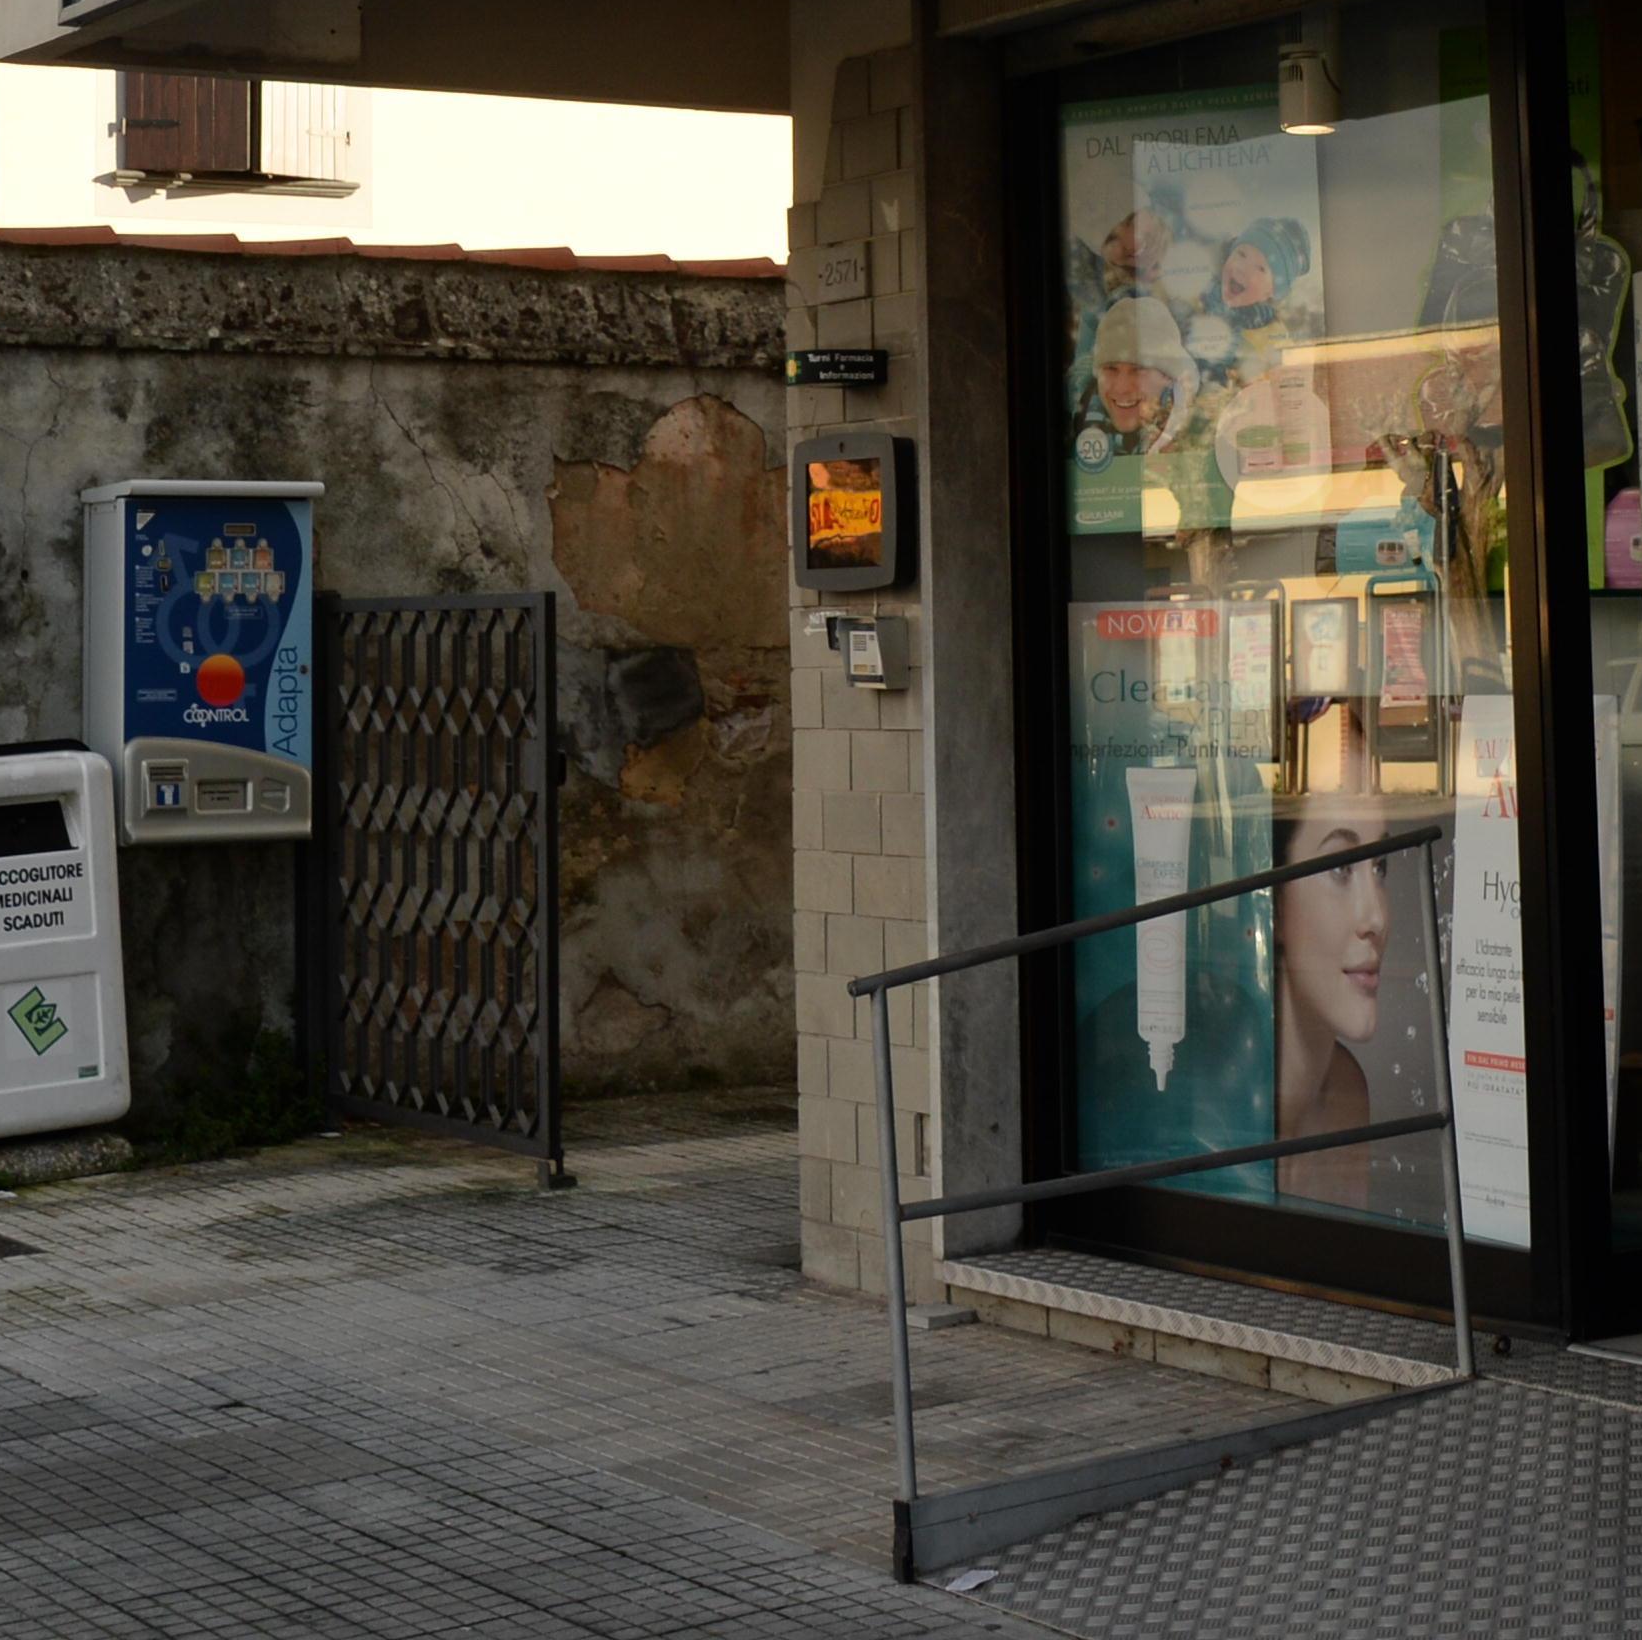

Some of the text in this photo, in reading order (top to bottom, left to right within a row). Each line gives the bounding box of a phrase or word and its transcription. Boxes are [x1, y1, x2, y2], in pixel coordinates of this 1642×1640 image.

[1086, 124, 1240, 159] DAL PROBLEMA
[1148, 154, 1160, 174] A
[272, 646, 304, 757] Adapta
[3, 911, 64, 932] SCADUTI
[1487, 960, 1507, 983] lunga
[1476, 1007, 1508, 1026] sensibile
